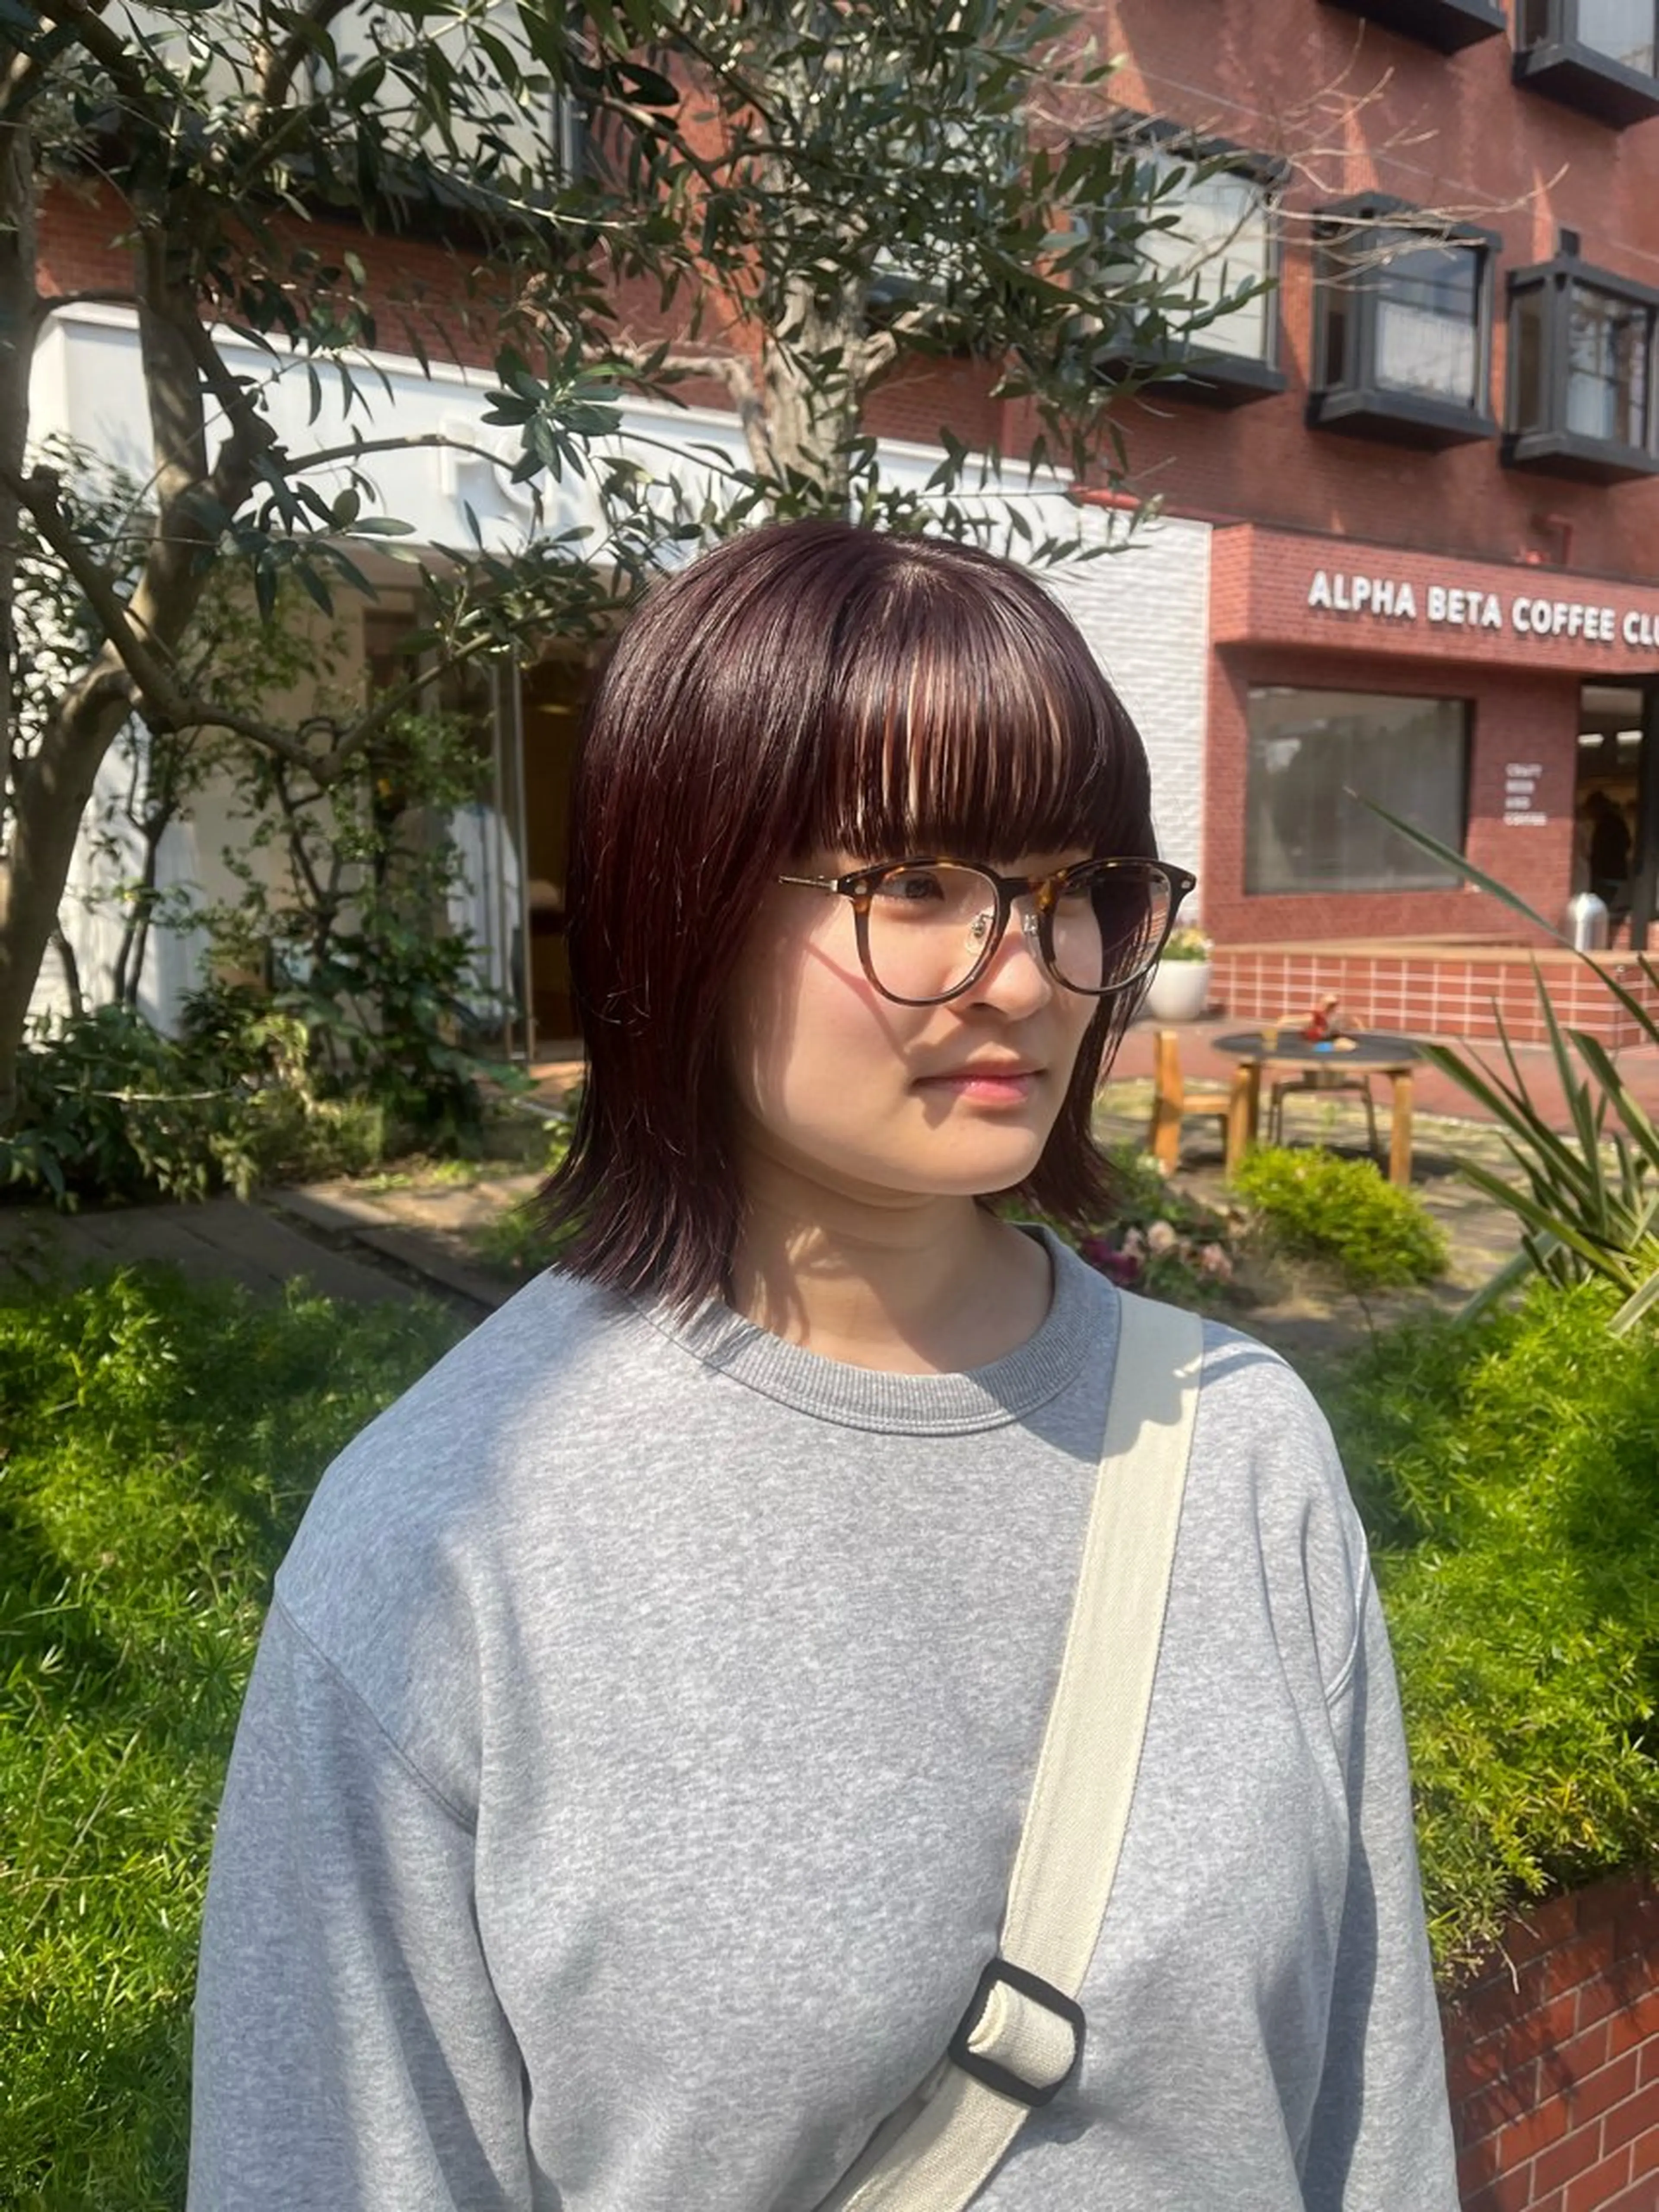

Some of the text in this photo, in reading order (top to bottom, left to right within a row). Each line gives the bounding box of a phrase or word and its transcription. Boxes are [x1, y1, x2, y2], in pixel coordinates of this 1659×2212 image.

[1308, 570, 1417, 619] ALPHA
[1428, 585, 1502, 629] BETA
[1513, 597, 1615, 641] COFFEE
